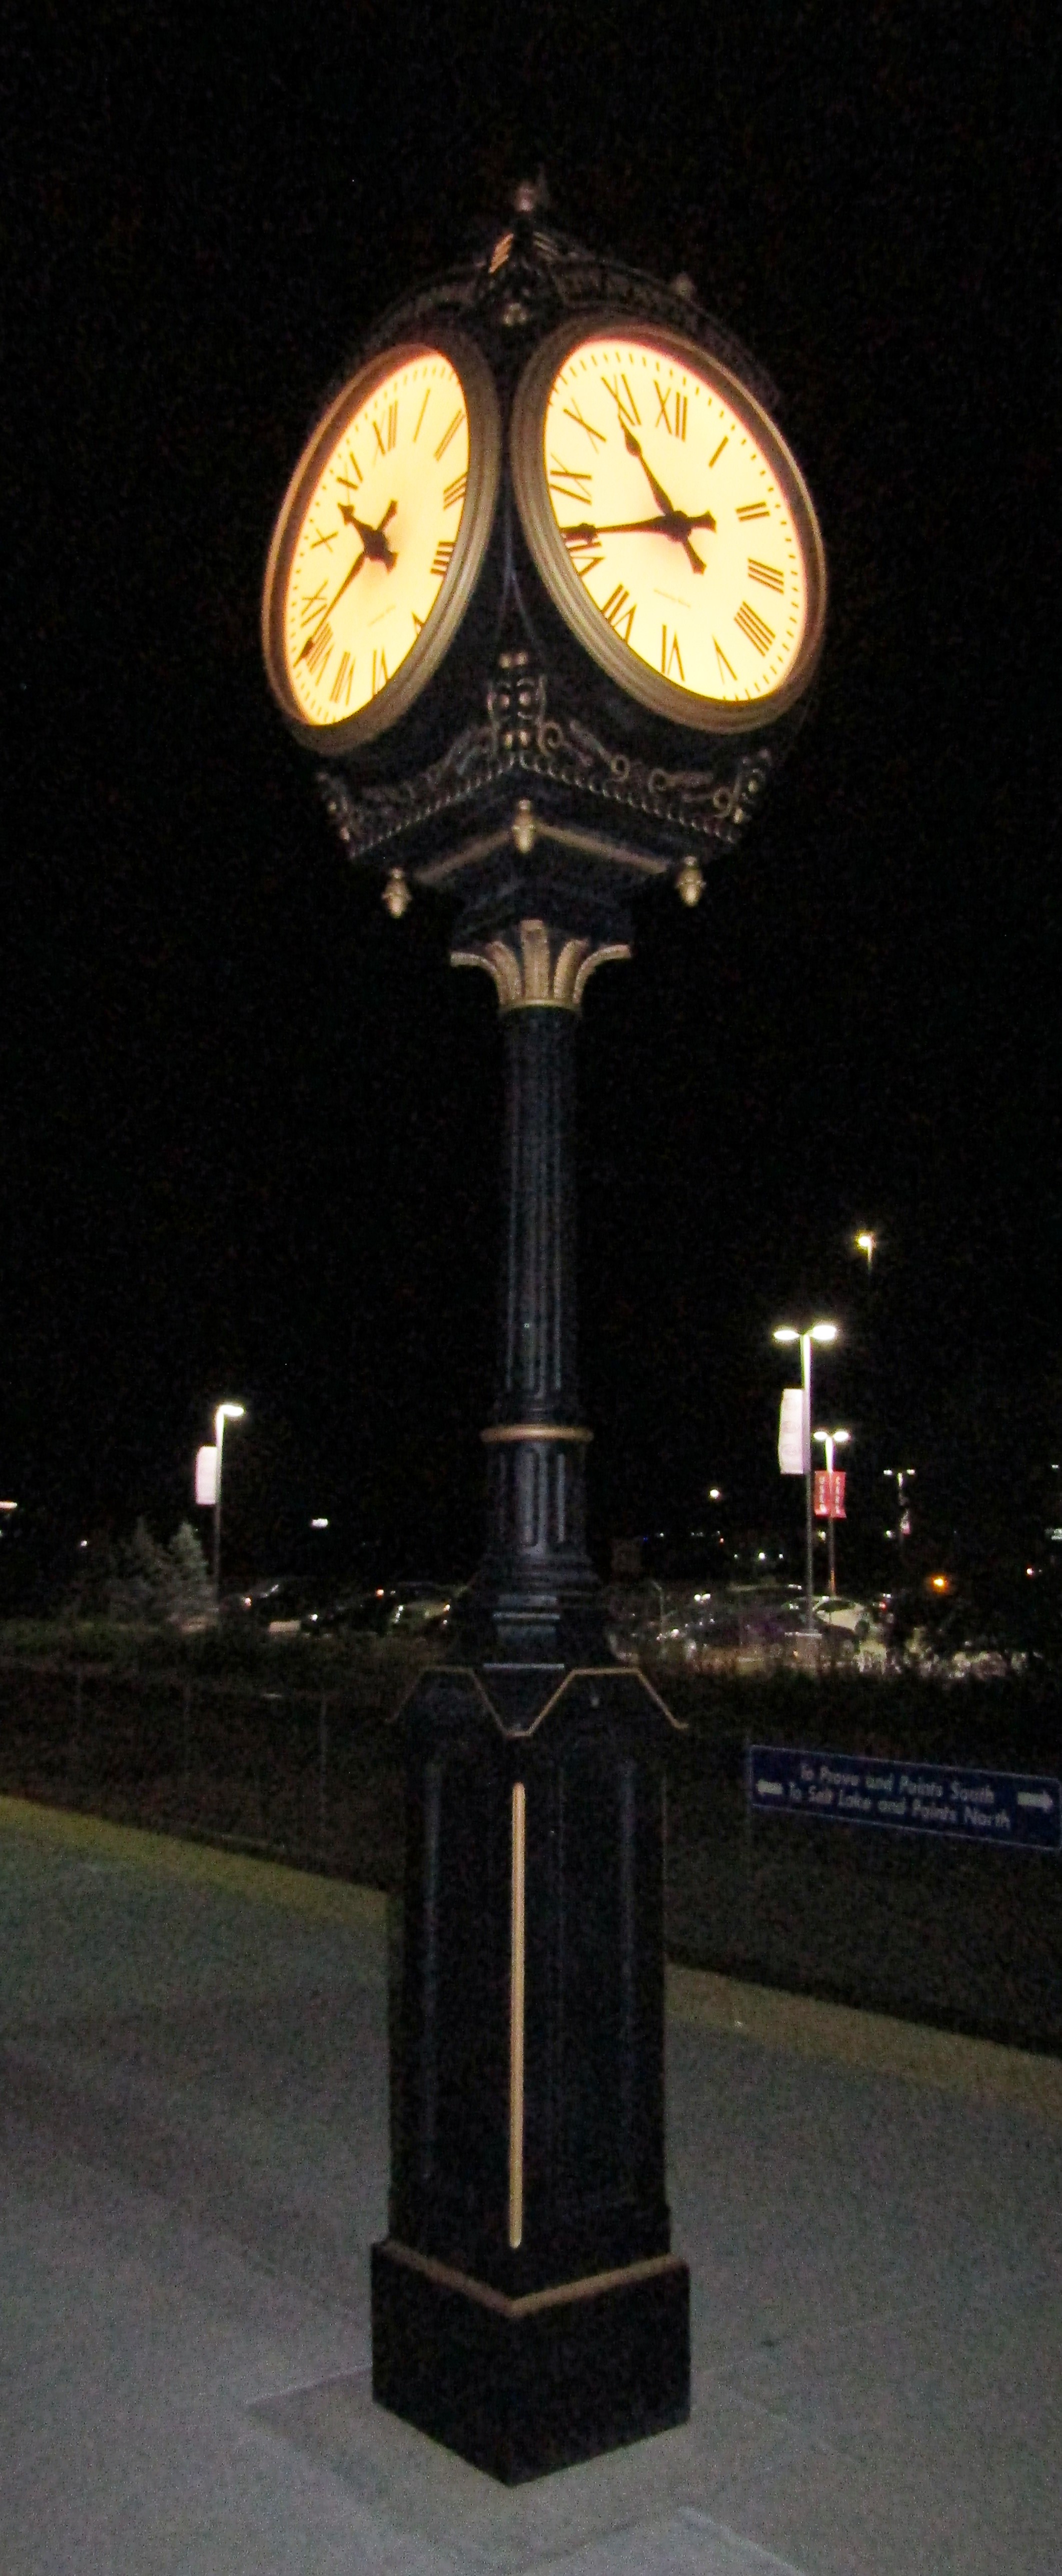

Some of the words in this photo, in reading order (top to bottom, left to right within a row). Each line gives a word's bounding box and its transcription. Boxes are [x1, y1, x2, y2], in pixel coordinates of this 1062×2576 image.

[413, 388, 430, 443] I
[563, 396, 607, 454] X
[601, 373, 641, 426] XI
[654, 380, 687, 442] XII
[372, 400, 398, 467] XII
[434, 408, 466, 462] II
[708, 436, 729, 468] I
[336, 452, 363, 504] XI
[443, 472, 467, 511] III
[549, 452, 592, 505] IX
[735, 502, 770, 522] II
[310, 528, 339, 553] X
[748, 558, 784, 594] III
[300, 578, 328, 628] IX
[601, 582, 637, 644] VII
[734, 600, 775, 658] IIII
[329, 650, 356, 706] VII
[371, 645, 389, 698] VI
[661, 623, 685, 682] VI
[712, 636, 738, 685] V
[789, 1781, 802, 1802] To
[808, 1785, 833, 1804] Salt
[837, 1789, 872, 1811] Lake
[877, 1796, 906, 1815] and
[911, 1798, 957, 1822] Points
[963, 1806, 1011, 1830] North
[800, 1762, 814, 1781] To
[819, 1766, 860, 1786] Provo
[865, 1772, 894, 1791] and
[899, 1774, 943, 1798] Points
[950, 1780, 995, 1804] South
